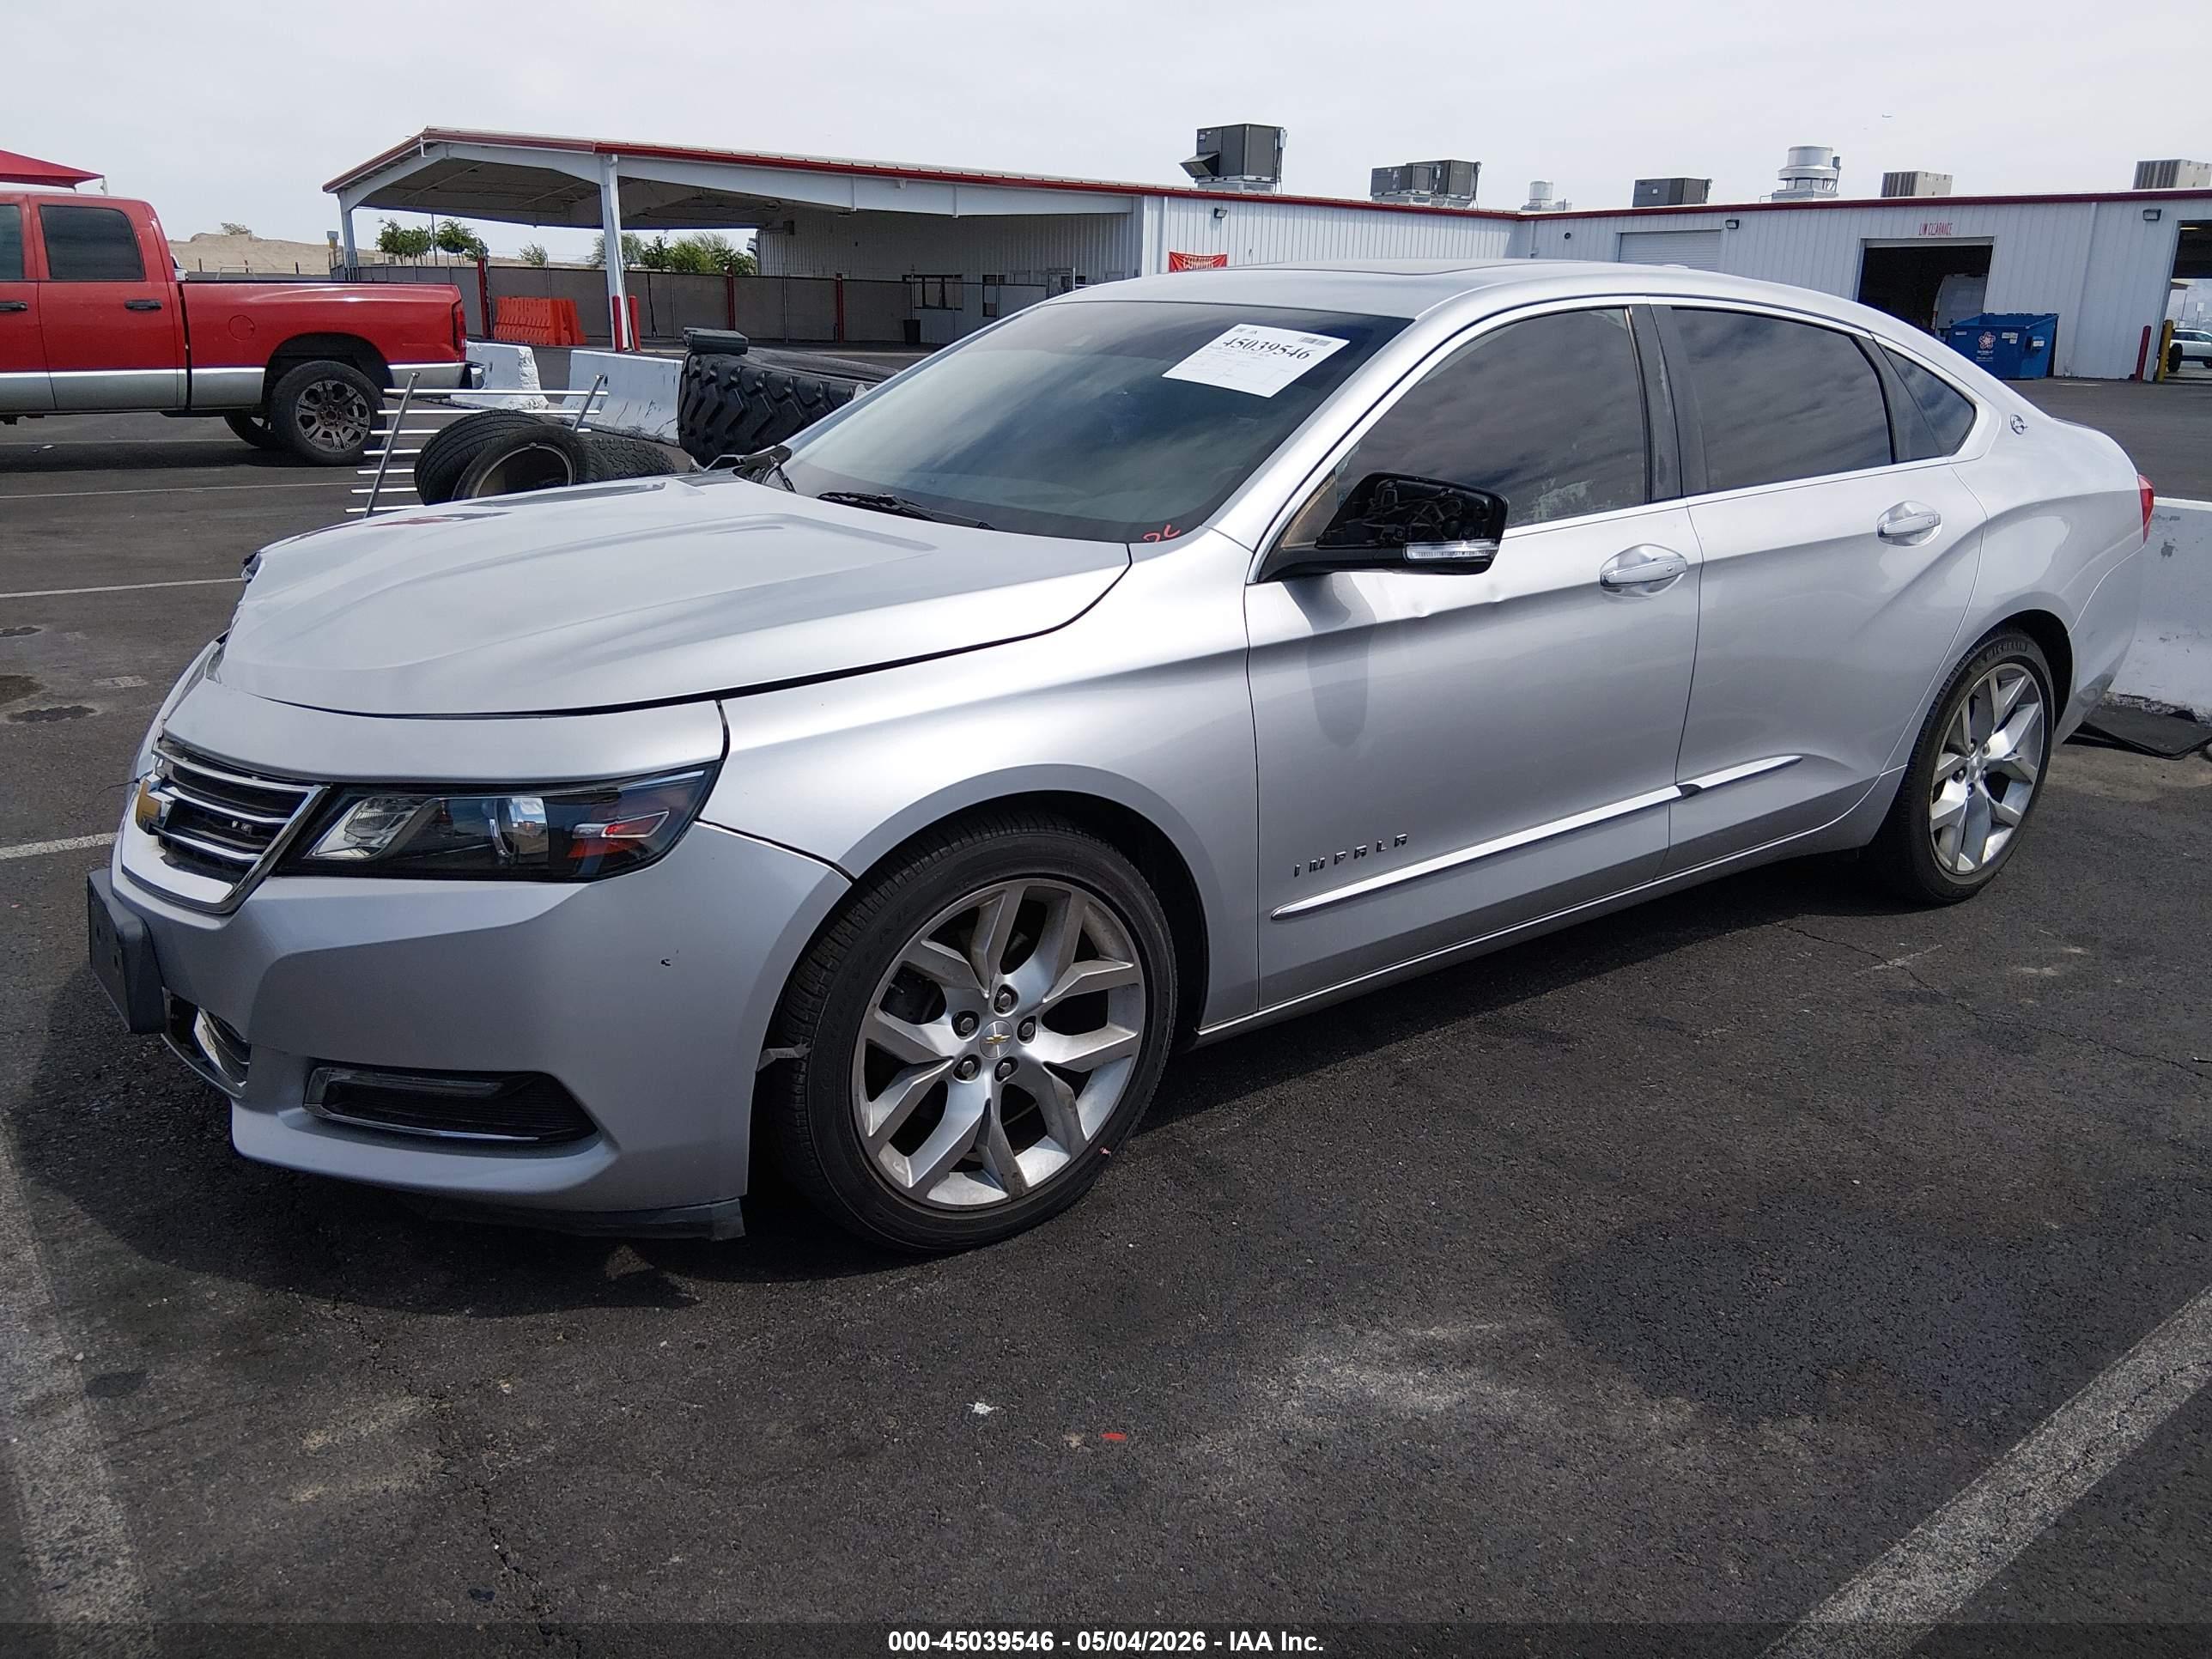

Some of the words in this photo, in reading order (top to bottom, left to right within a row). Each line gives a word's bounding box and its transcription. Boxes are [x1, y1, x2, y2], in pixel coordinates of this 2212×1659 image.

[1929, 222, 1953, 235] CLEARANCE
[1182, 257, 1214, 270] COMING
[1223, 337, 1313, 360] 45039546
[1293, 833, 1408, 878] IMPALA
